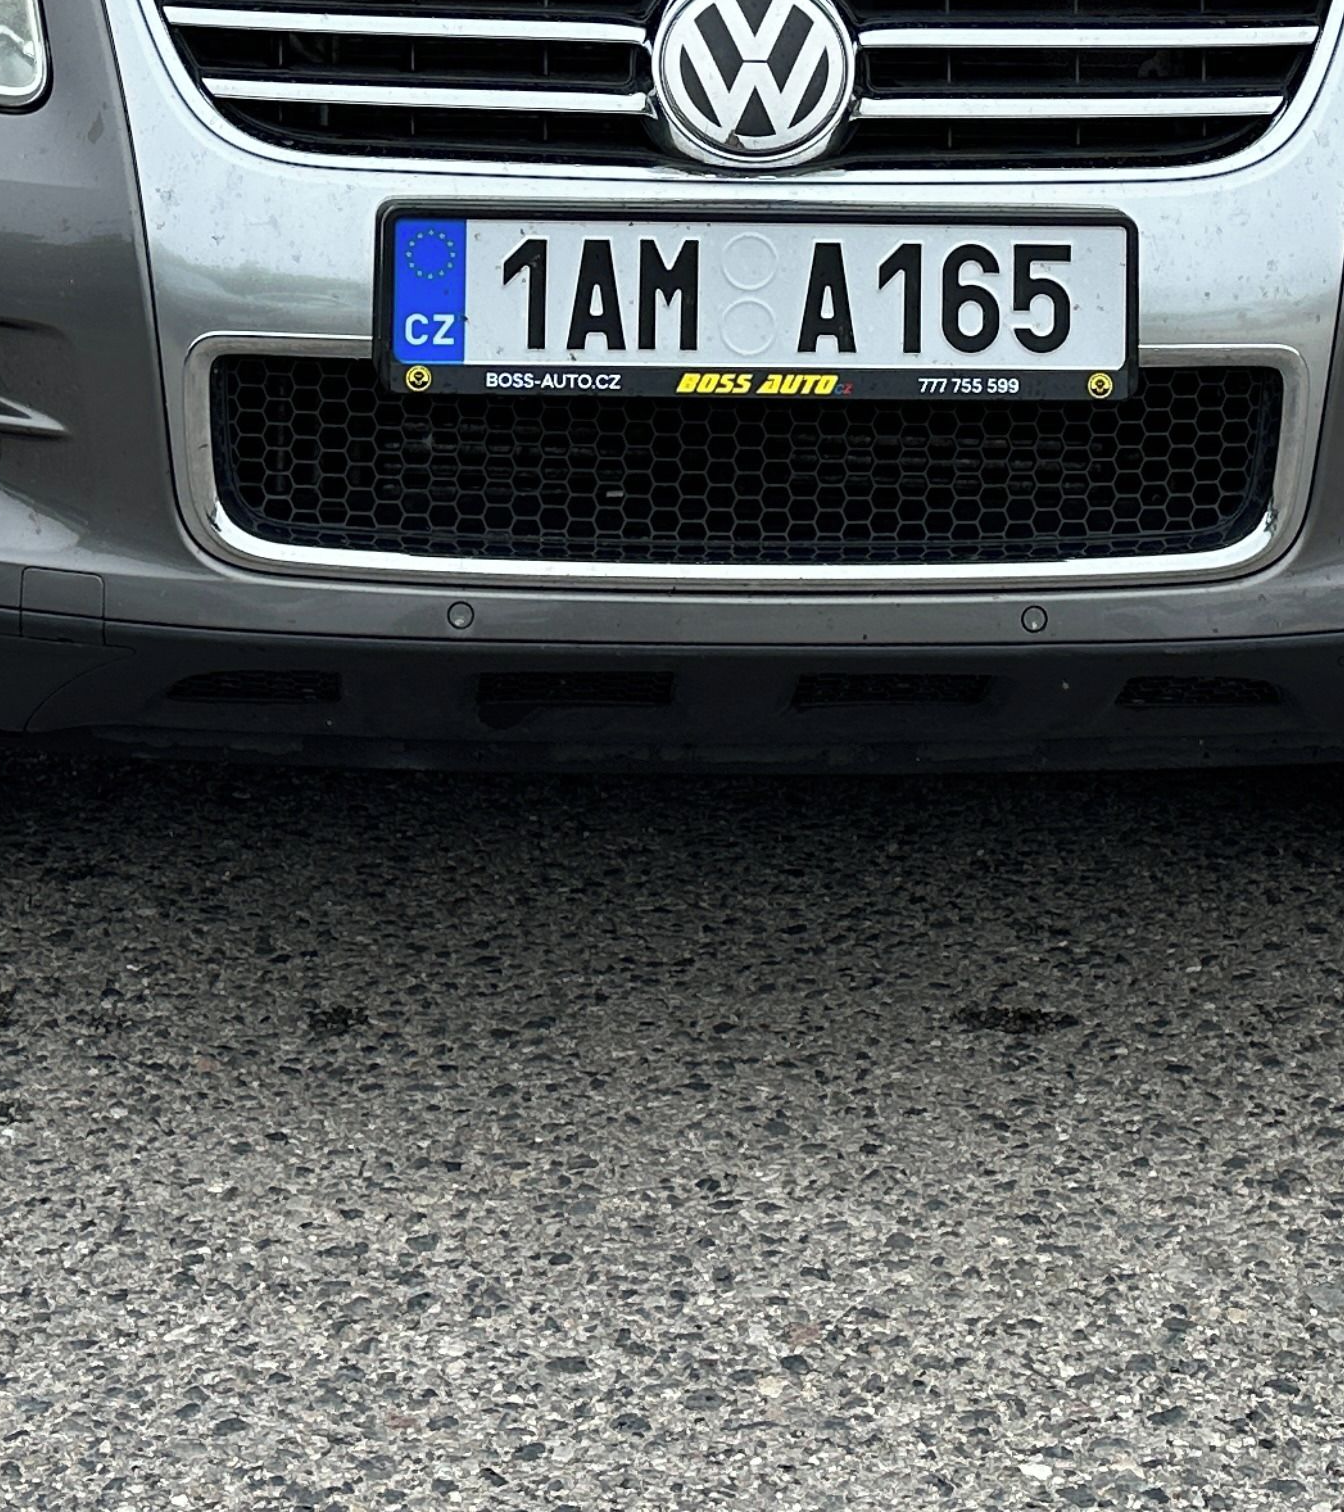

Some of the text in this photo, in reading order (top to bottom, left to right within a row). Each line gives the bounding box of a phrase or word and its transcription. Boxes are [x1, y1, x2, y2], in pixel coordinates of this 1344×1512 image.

[501, 238, 1072, 354] 1AM A165
[404, 312, 455, 345] CZ
[485, 371, 622, 390] BOSS-AUTO.CZ
[676, 373, 754, 393] BOSS
[758, 375, 838, 394] AUTO
[918, 377, 1020, 393] 777 755 599
